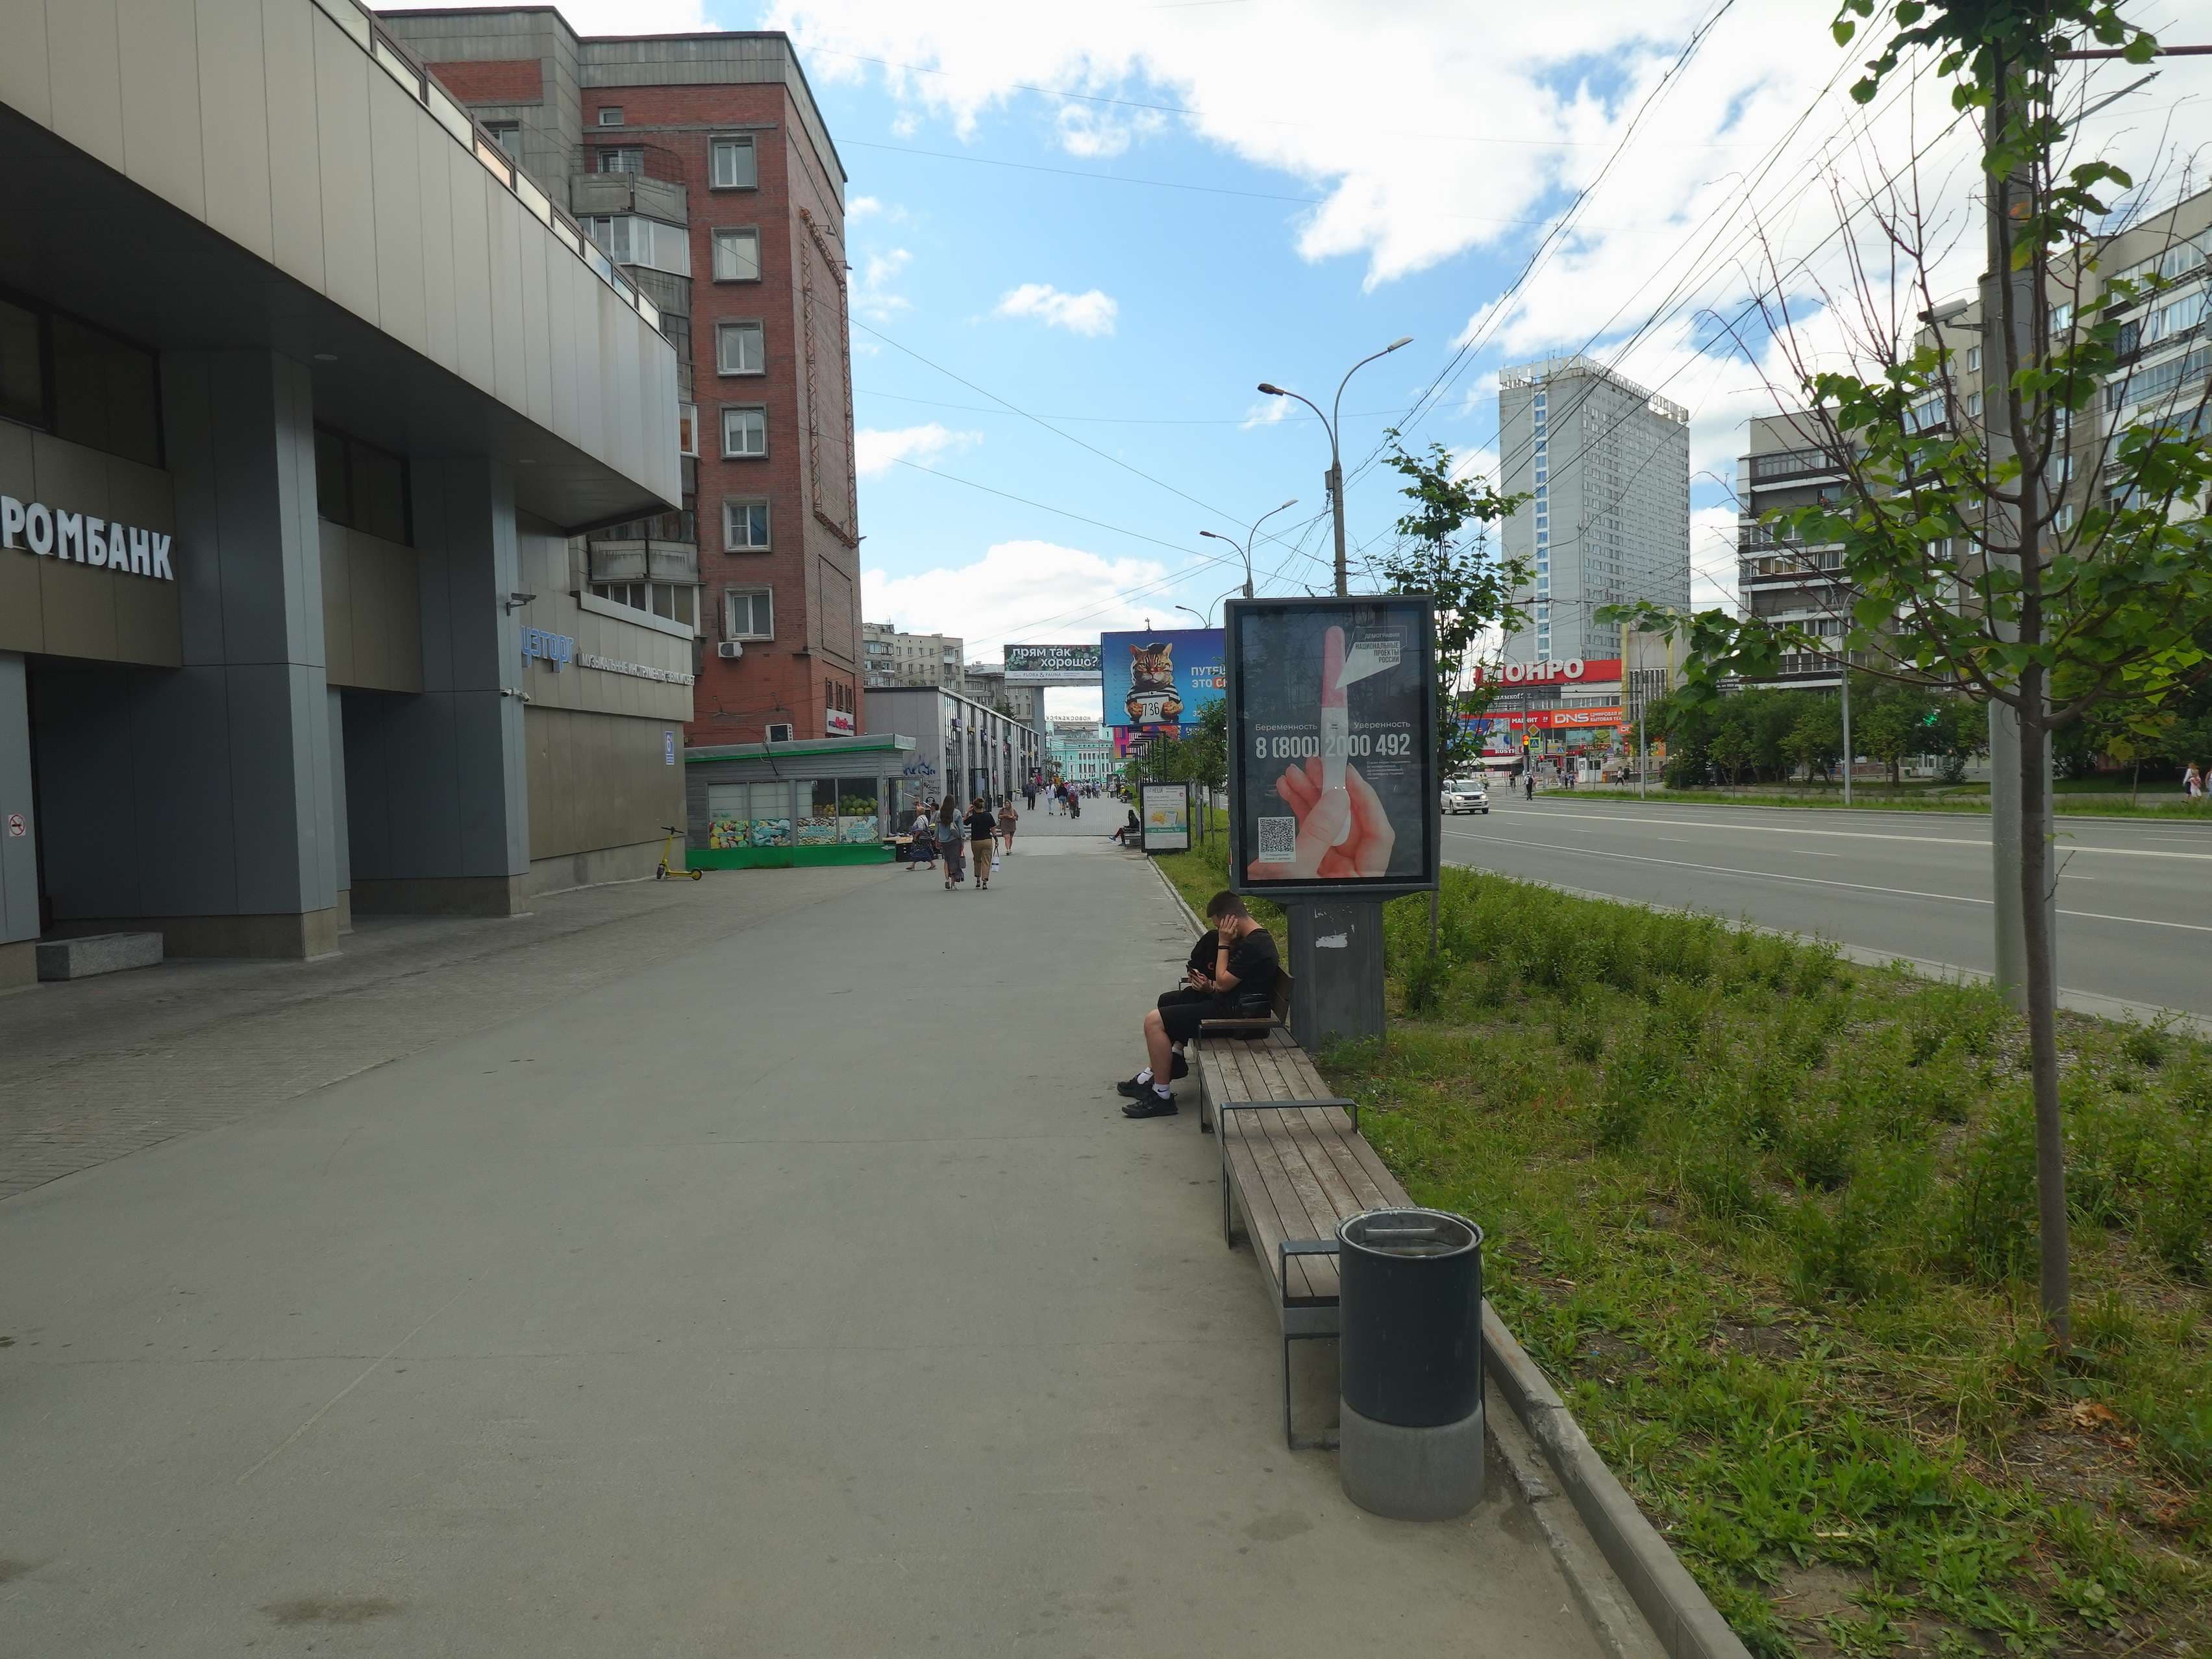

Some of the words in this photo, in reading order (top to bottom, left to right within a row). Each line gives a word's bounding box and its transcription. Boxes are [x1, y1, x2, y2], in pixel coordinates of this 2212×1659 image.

[1, 495, 173, 580] РОМБАНК
[1013, 648, 1046, 658] прям
[1049, 648, 1072, 656] так
[1041, 656, 1099, 669] хорошо?
[1192, 679, 1213, 688] ЭТО
[1554, 712, 1590, 724] DNS
[1255, 723, 1318, 732] Беременность
[1353, 721, 1411, 730] Уверенность
[1256, 736, 1267, 759] 8
[1272, 736, 1320, 758] (800)
[1325, 734, 1371, 758] 2000
[1375, 733, 1411, 756] 492
